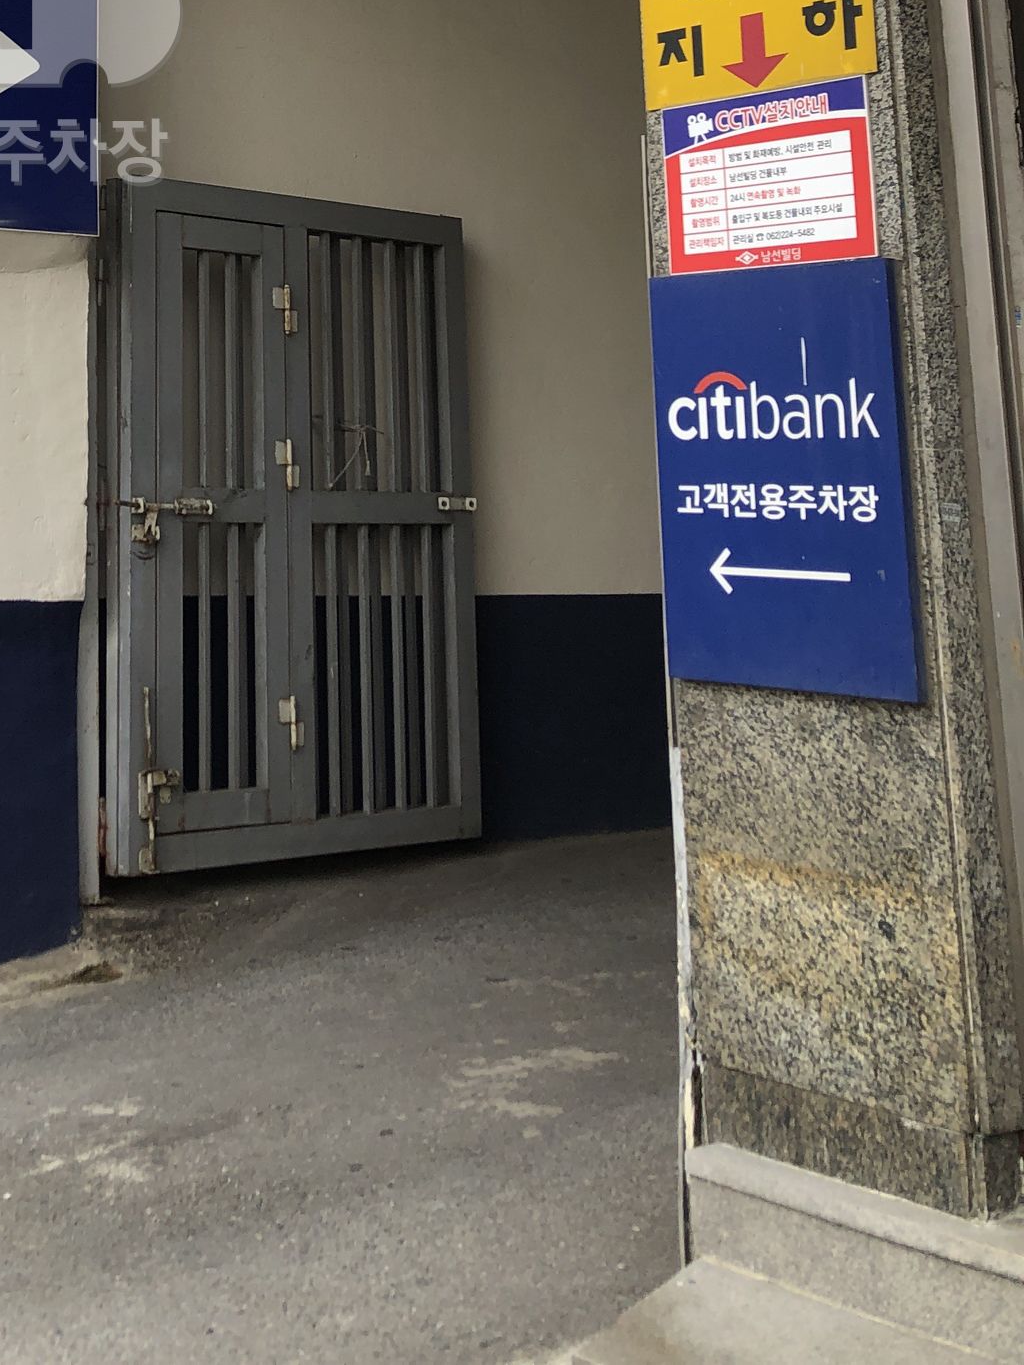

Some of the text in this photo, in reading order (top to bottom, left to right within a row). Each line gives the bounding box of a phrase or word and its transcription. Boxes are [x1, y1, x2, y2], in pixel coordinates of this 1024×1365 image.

[715, 93, 829, 132] CCTV설치안내
[760, 247, 802, 263] 남선빌딩
[667, 374, 881, 441] citibank
[676, 483, 880, 523] 고객전용주차장
